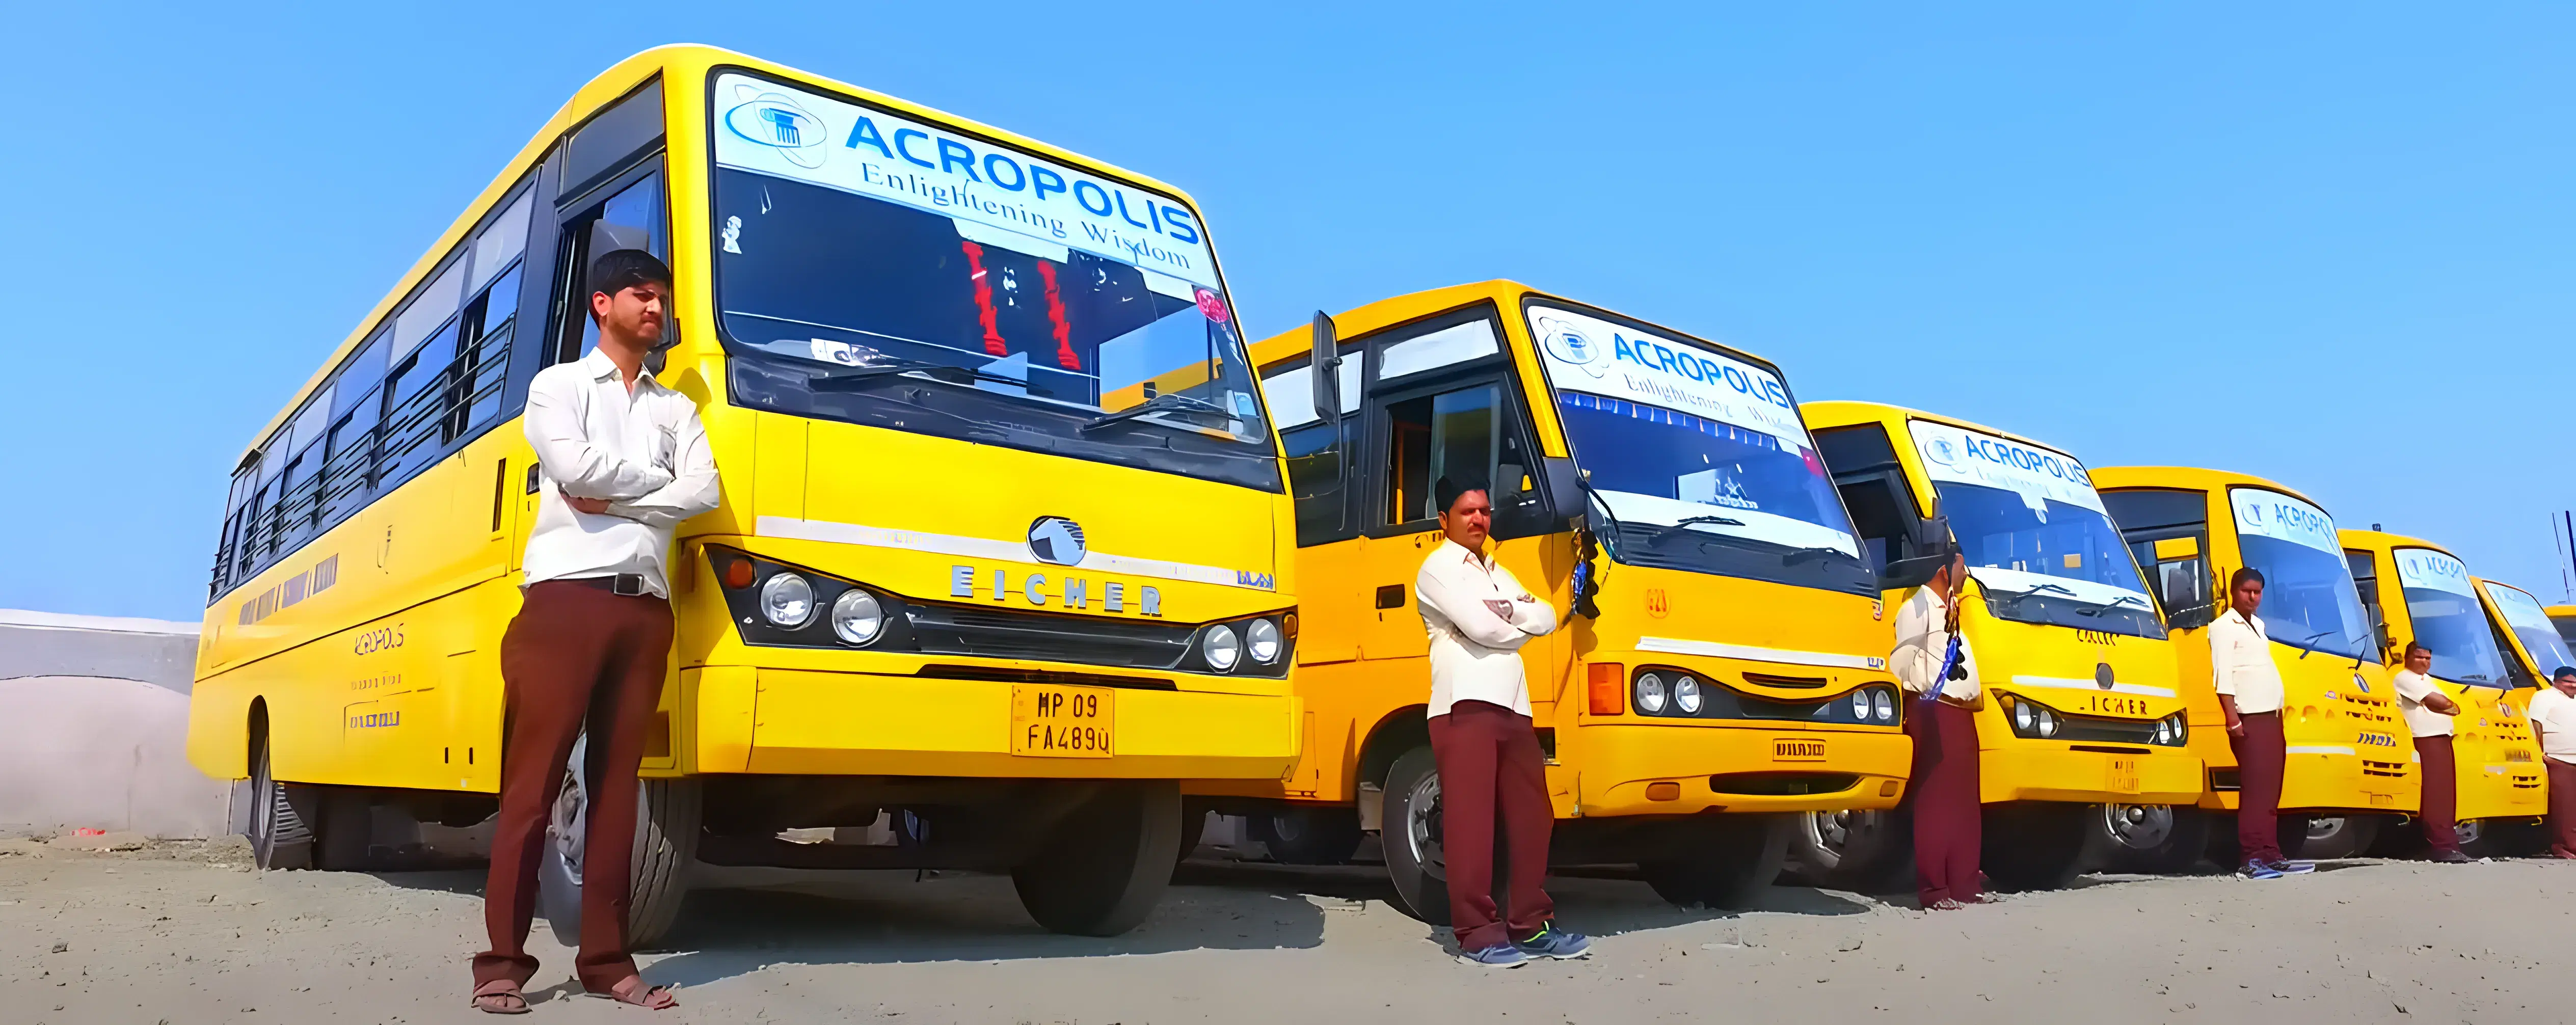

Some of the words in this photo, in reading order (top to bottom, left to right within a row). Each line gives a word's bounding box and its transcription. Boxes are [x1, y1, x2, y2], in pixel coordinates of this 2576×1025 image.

[845, 116, 1199, 245] ACROPOLIS
[863, 163, 1067, 238] Enlightening
[1081, 221, 1190, 269] Wisdom
[1614, 332, 1789, 409] ACROPOLIS
[1966, 435, 2090, 487] ACROPOLIS
[951, 564, 1162, 617] EICHER
[1038, 692, 1063, 717] MP
[1073, 694, 1097, 718] 09
[2079, 695, 2148, 715] ICHER
